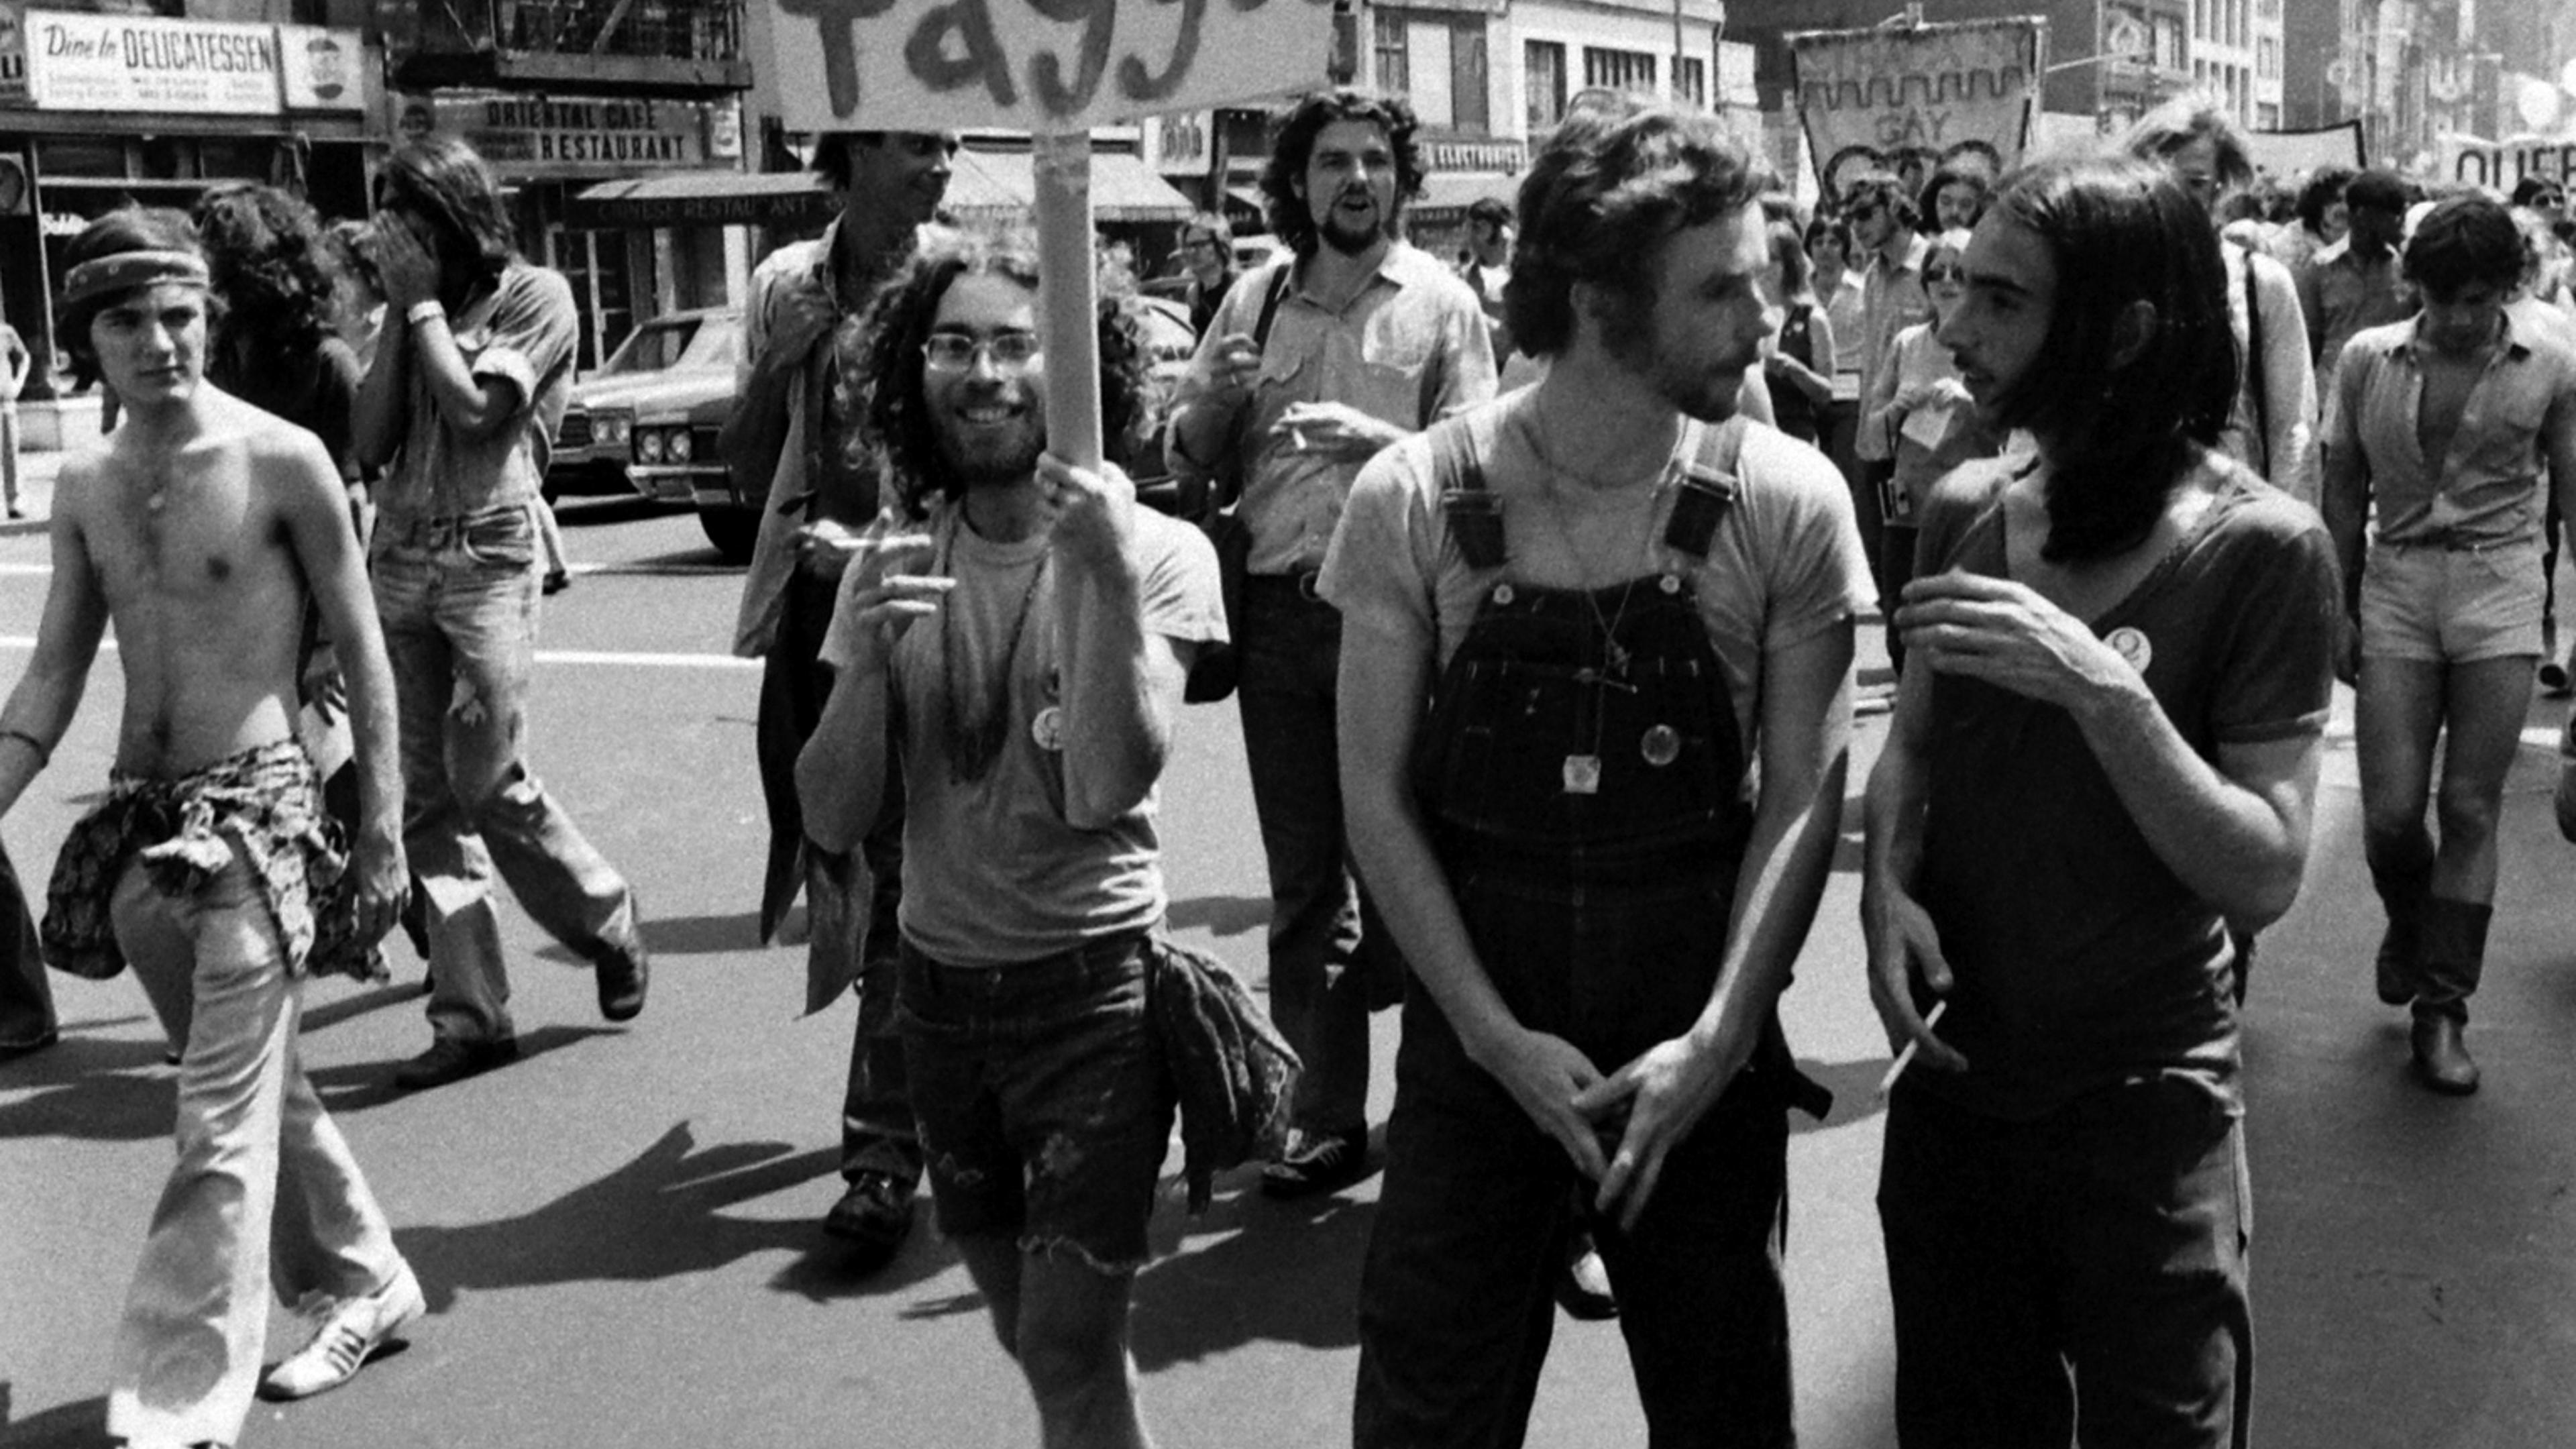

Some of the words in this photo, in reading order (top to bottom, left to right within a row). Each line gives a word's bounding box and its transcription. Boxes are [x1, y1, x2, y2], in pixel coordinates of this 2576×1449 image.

[44, 25, 93, 56] Dine
[122, 28, 272, 72] DELICATESSEN
[487, 102, 593, 128] ORIENTAL
[1874, 107, 1951, 146] GAY
[542, 135, 684, 159] RESTAURANT
